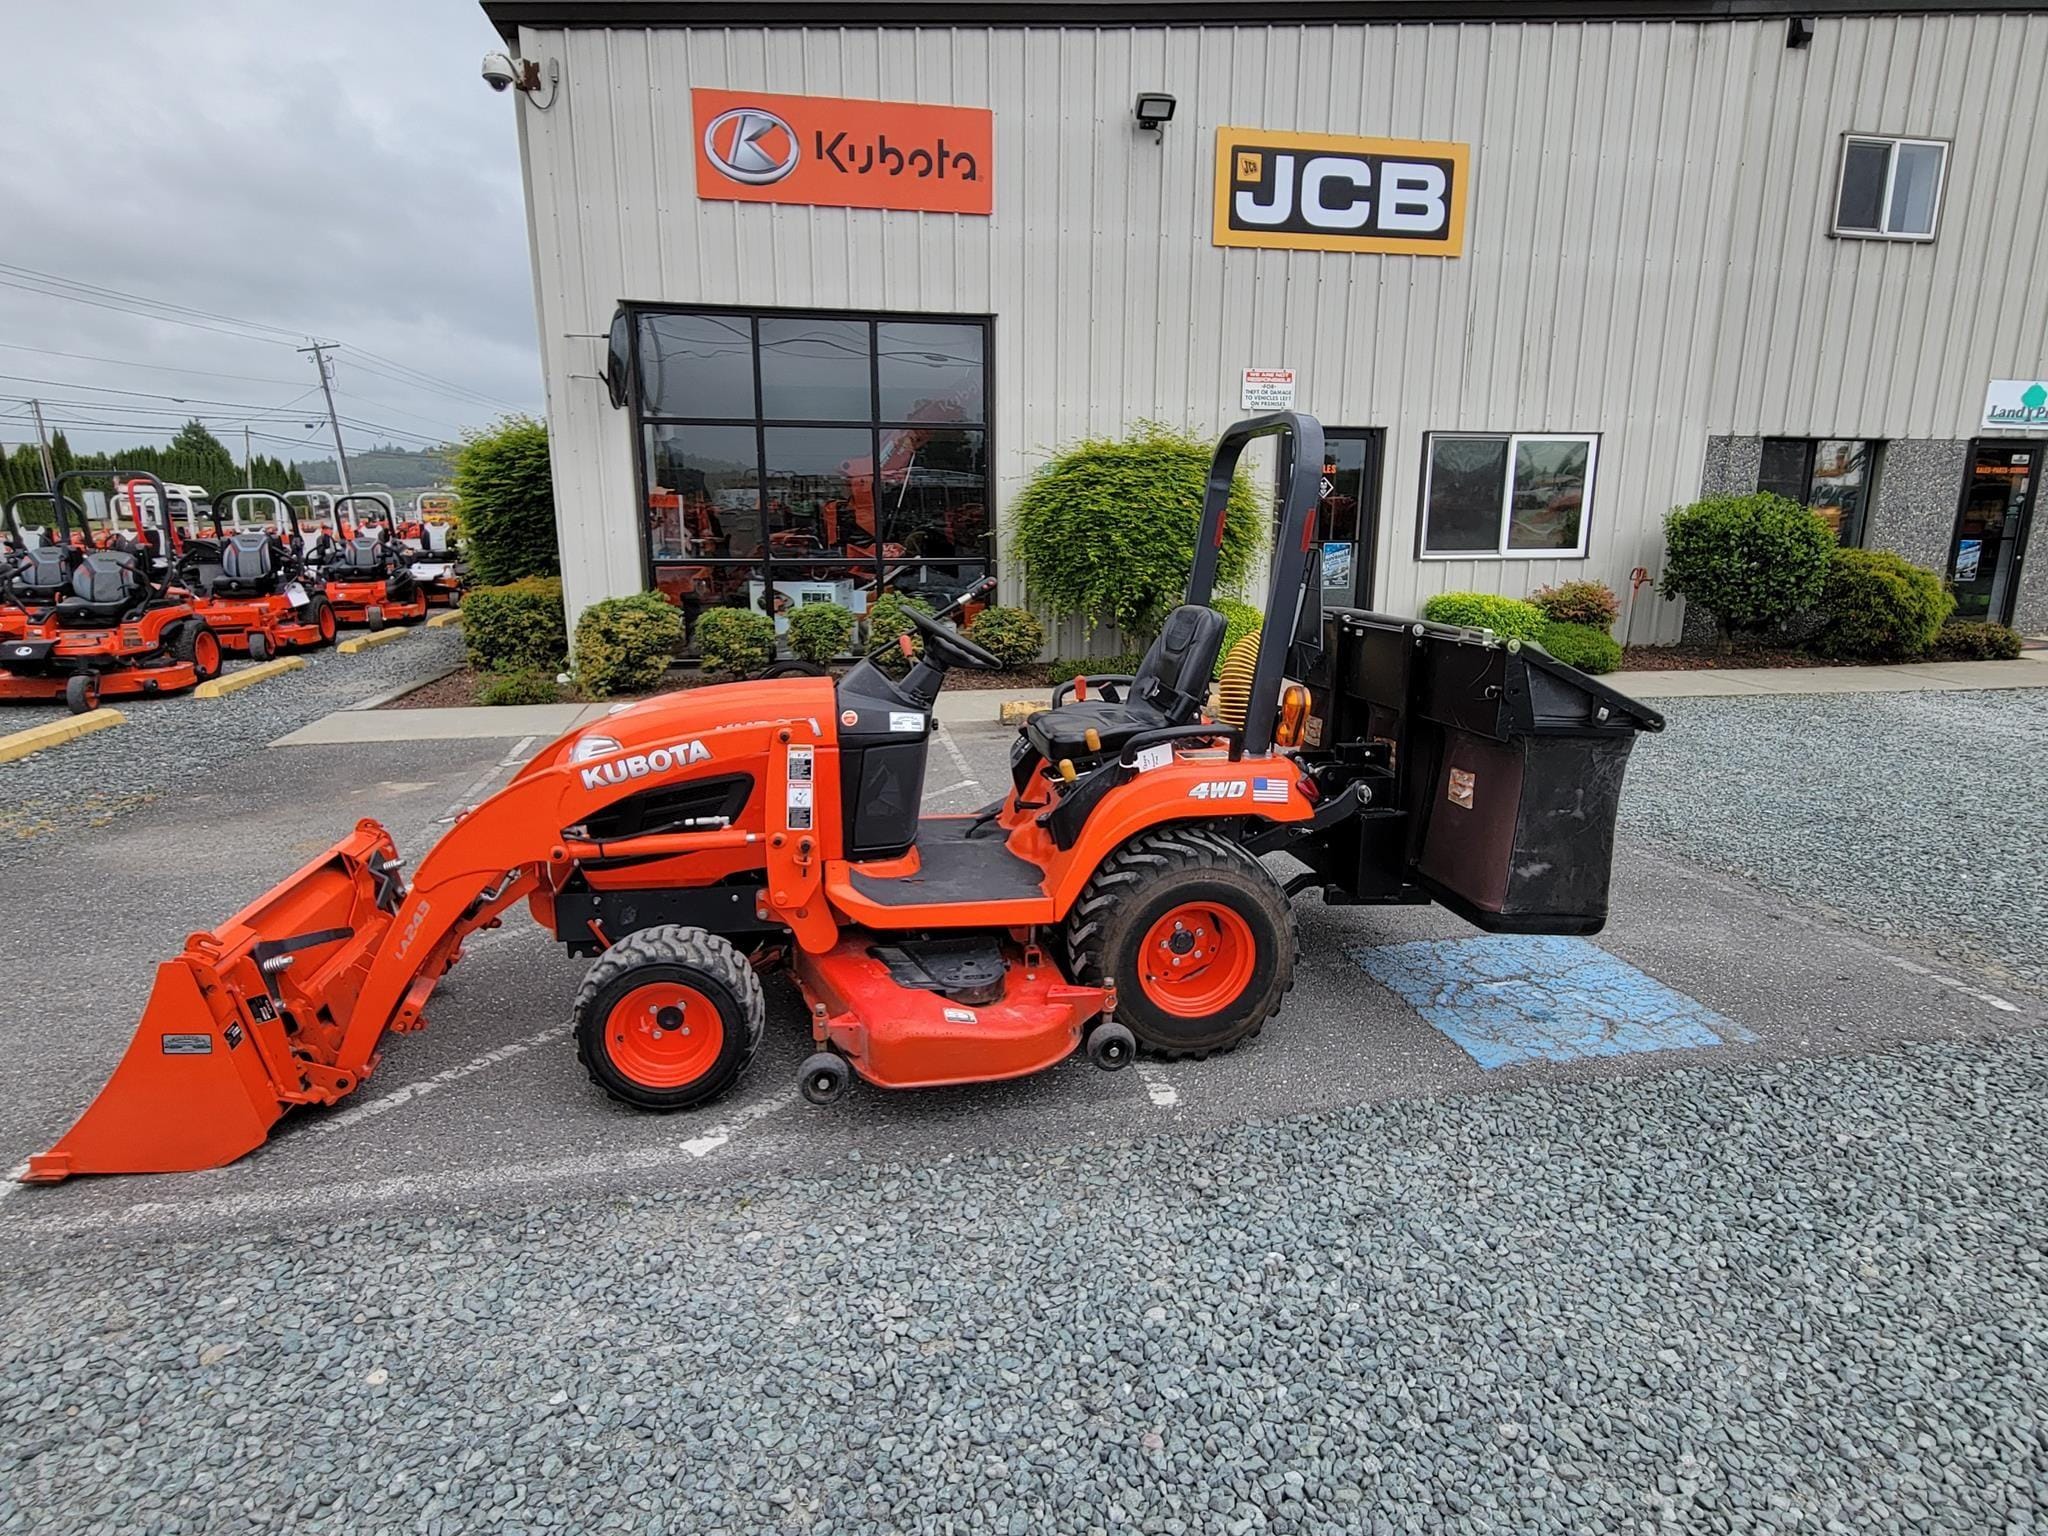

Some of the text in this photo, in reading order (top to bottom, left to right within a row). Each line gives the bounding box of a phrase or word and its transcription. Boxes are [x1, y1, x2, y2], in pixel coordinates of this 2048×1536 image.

[815, 130, 977, 181] Kubota
[1235, 155, 1446, 232] JCB
[1990, 405, 2025, 418] Land
[1322, 464, 1336, 474] LES
[580, 739, 713, 791] KUBOTA
[1188, 780, 1246, 800] 4WD
